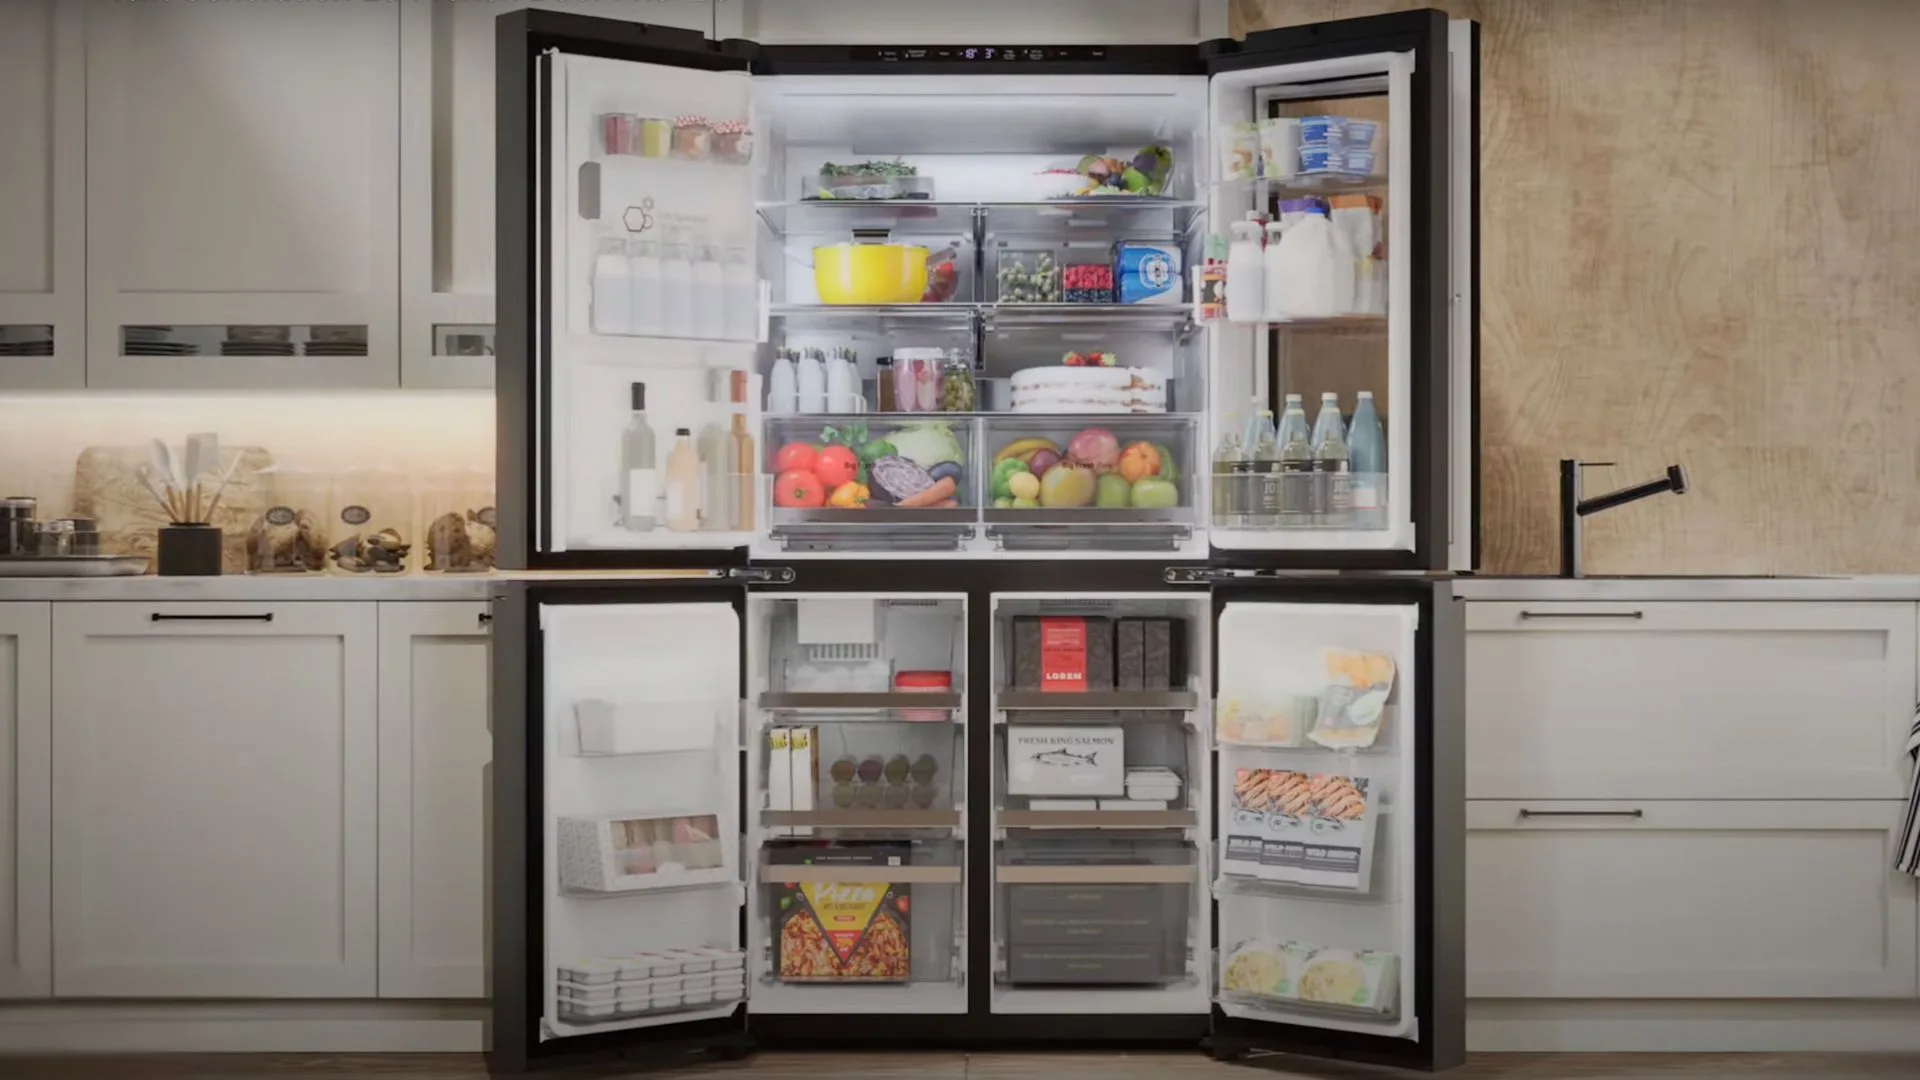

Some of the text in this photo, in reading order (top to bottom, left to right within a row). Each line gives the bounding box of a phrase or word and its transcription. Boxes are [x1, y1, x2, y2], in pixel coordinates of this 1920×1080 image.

[1046, 672, 1083, 681] LOREM
[1018, 736, 1115, 746] FRESH KING SALMON
